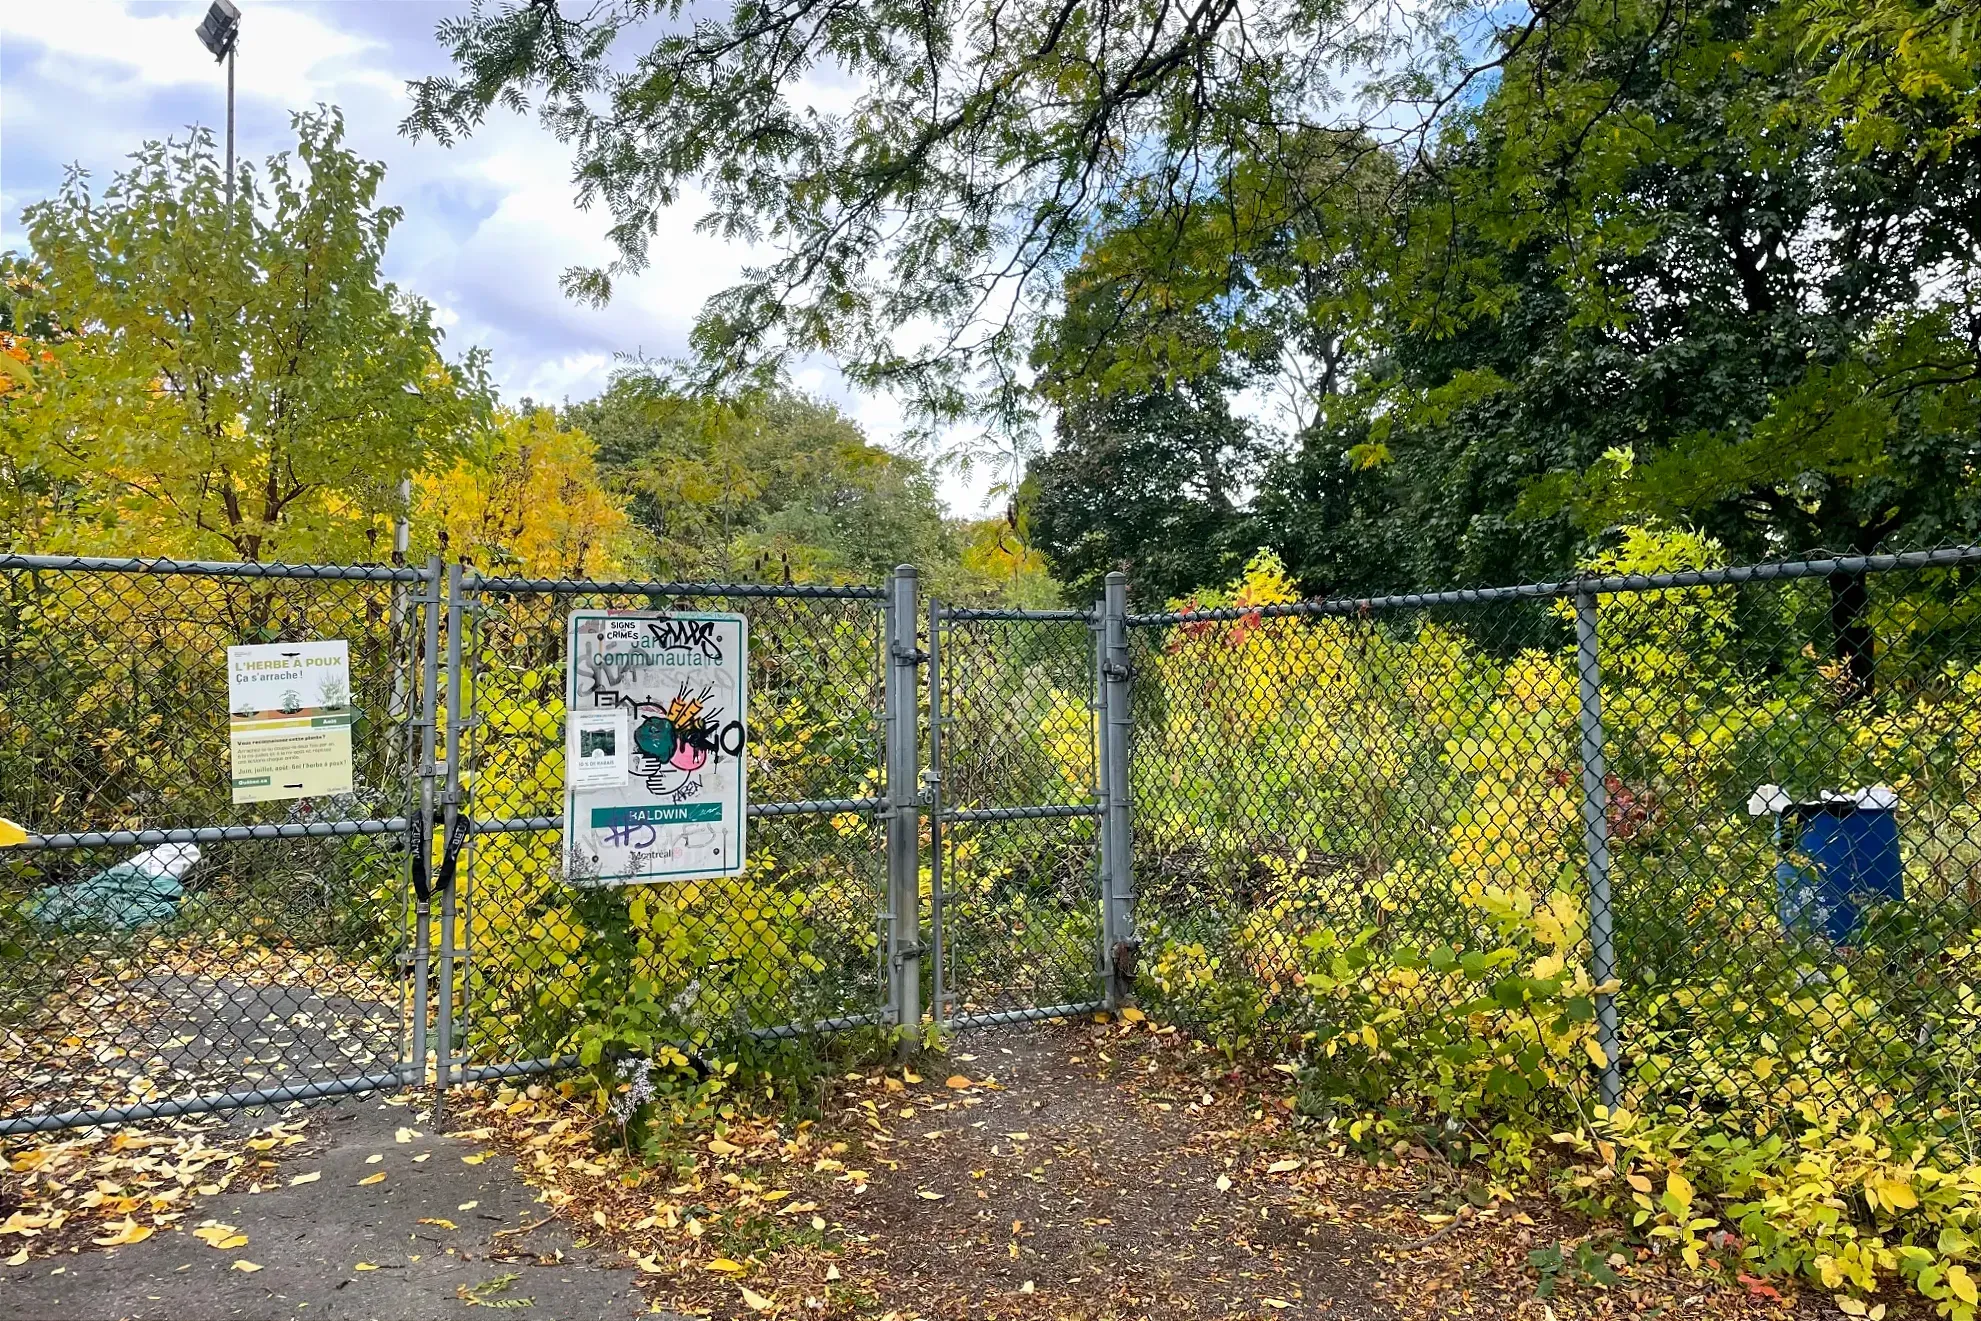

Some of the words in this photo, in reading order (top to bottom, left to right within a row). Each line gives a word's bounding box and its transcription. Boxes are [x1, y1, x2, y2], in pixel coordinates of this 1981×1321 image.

[611, 621, 636, 629] SIGNS
[607, 630, 639, 640] CRIMES
[235, 660, 289, 671] L'HERBE
[293, 657, 302, 668] À
[306, 657, 341, 667] POUX
[236, 673, 249, 685] Ça
[629, 808, 688, 822] BALDWIN
